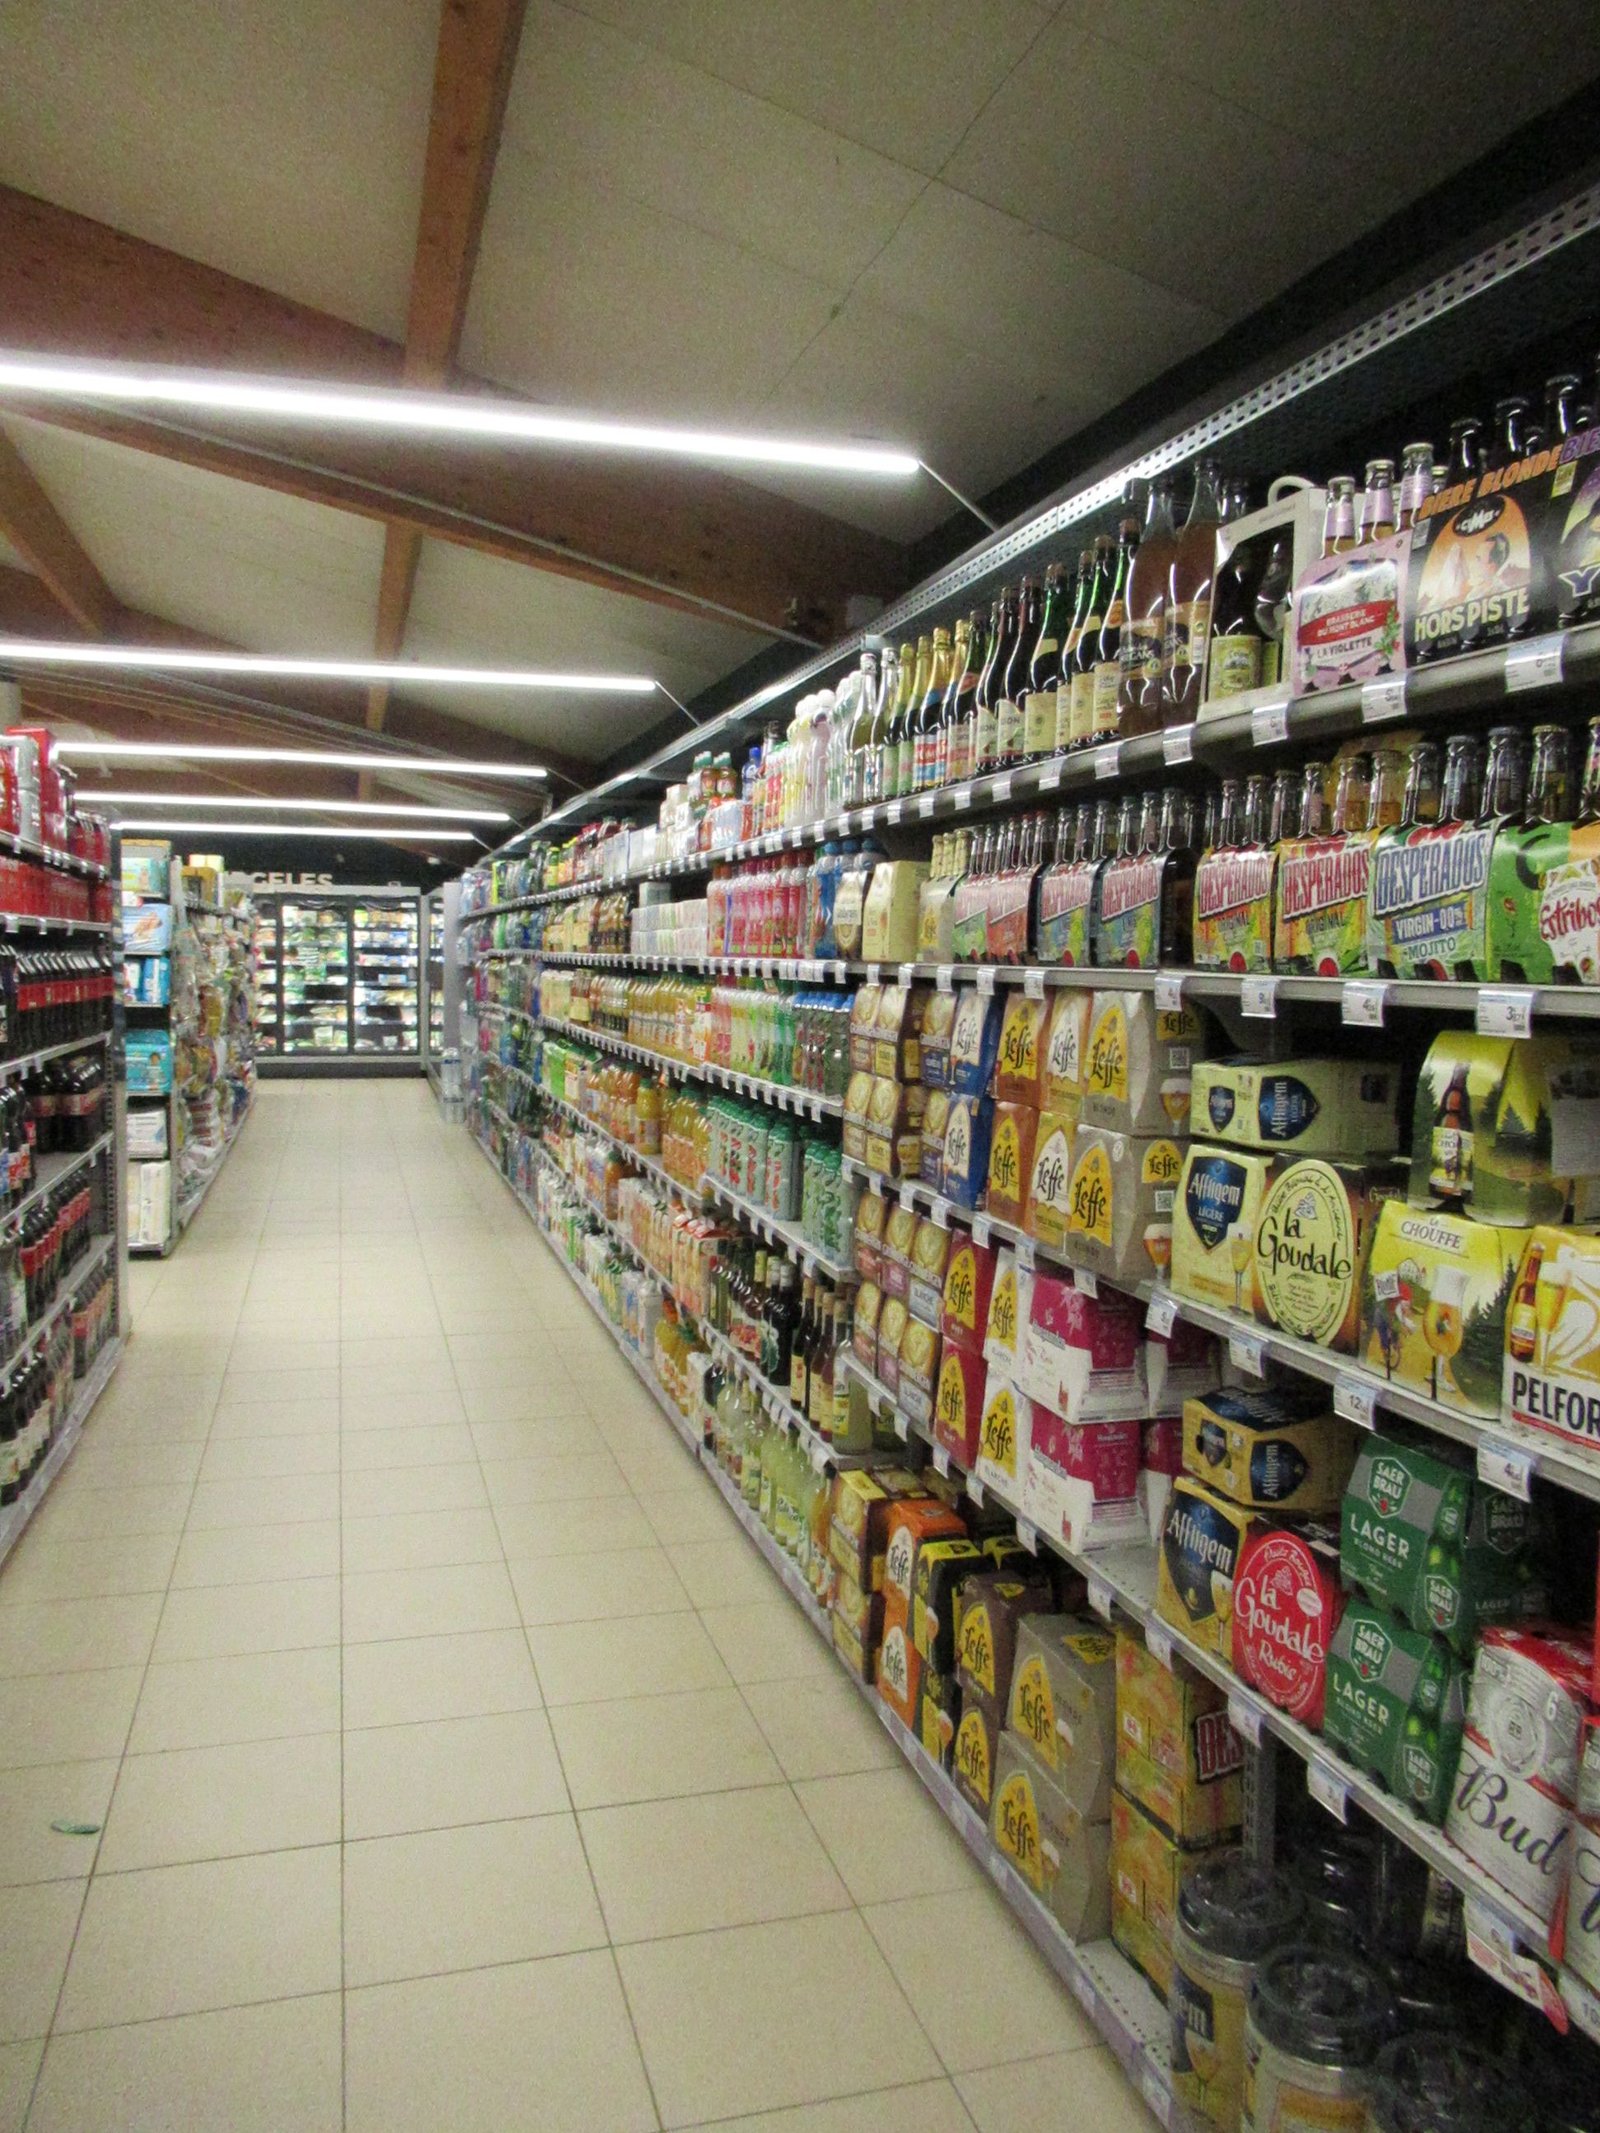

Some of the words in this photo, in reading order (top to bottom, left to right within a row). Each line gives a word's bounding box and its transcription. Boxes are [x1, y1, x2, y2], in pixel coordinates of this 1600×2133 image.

[1477, 444, 1564, 498] BLONDE
[1414, 604, 1466, 643] HORS
[1466, 588, 1531, 628] PISTE
[1329, 635, 1373, 655] VIOLETTE
[1200, 858, 1269, 914] DESPERADOS
[1284, 849, 1369, 915] DESPERADOS
[1377, 834, 1487, 911] DESPERADOS
[1408, 936, 1457, 959] MOJITO
[1004, 1025, 1034, 1069] Leffe
[1051, 1028, 1077, 1073] Leffe
[1091, 1037, 1123, 1089] Leffe
[993, 1144, 1016, 1188] Leffe
[1037, 1157, 1064, 1201] Leffe
[1149, 1153, 1179, 1178] Leffe
[1073, 1175, 1107, 1229] Leffe
[1188, 1172, 1241, 1207] Affligem
[1257, 1216, 1352, 1280] Goudale
[1401, 1220, 1461, 1250] CHOUFFE
[949, 1271, 973, 1314] Leffe
[992, 1294, 1016, 1339] Leffe
[940, 1378, 961, 1422] Leffe
[986, 1413, 1012, 1461] Leffe
[1373, 1475, 1402, 1500] BRAU
[1377, 1460, 1405, 1486] SAER
[1167, 1509, 1233, 1573] Affligem
[1350, 1513, 1410, 1560] LAGER
[1235, 1577, 1324, 1664] Goudale
[1357, 1624, 1386, 1652] SAER
[964, 1625, 990, 1672] Leffe
[1259, 1640, 1298, 1681] Rubis
[1020, 1683, 1051, 1743] Leffe
[1333, 1672, 1389, 1727] LAGER
[959, 1730, 985, 1780] Leffe
[1002, 1799, 1036, 1860] Leffe
[1456, 1749, 1570, 1876] Bud
